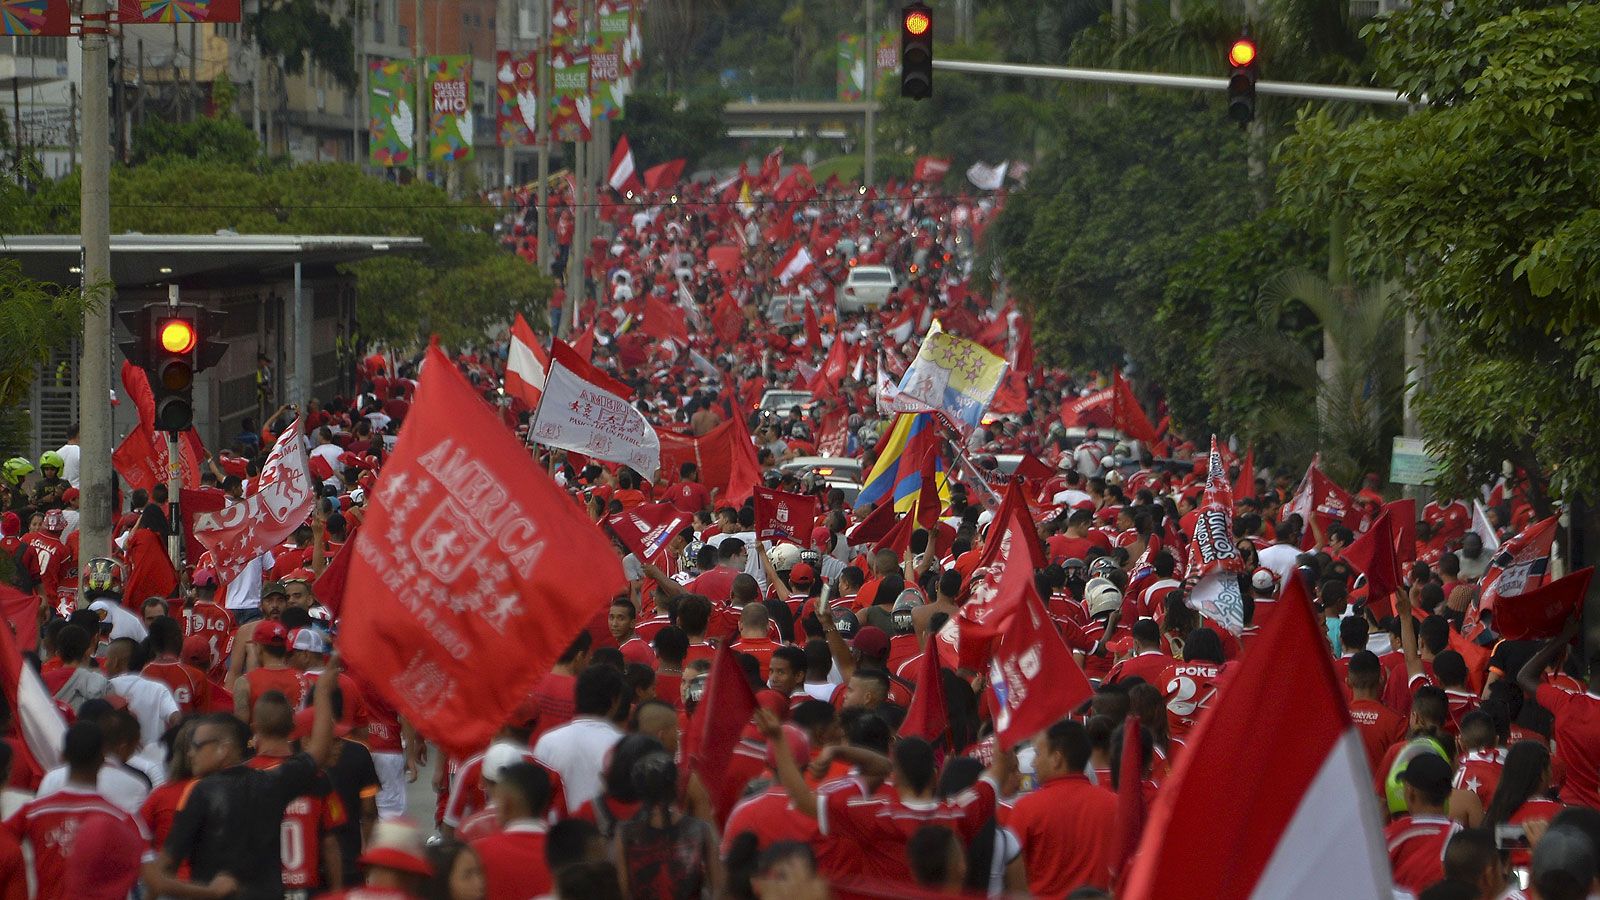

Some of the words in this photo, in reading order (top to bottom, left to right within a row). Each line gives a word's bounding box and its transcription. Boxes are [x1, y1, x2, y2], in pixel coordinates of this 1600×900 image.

[434, 81, 465, 90] DULCE
[434, 90, 465, 98] JESUS
[435, 98, 465, 111] MIO
[416, 438, 546, 581] AMERICA
[30, 539, 57, 555] AGUILA
[1175, 666, 1218, 678] POKE
[1349, 710, 1379, 720] mérica
